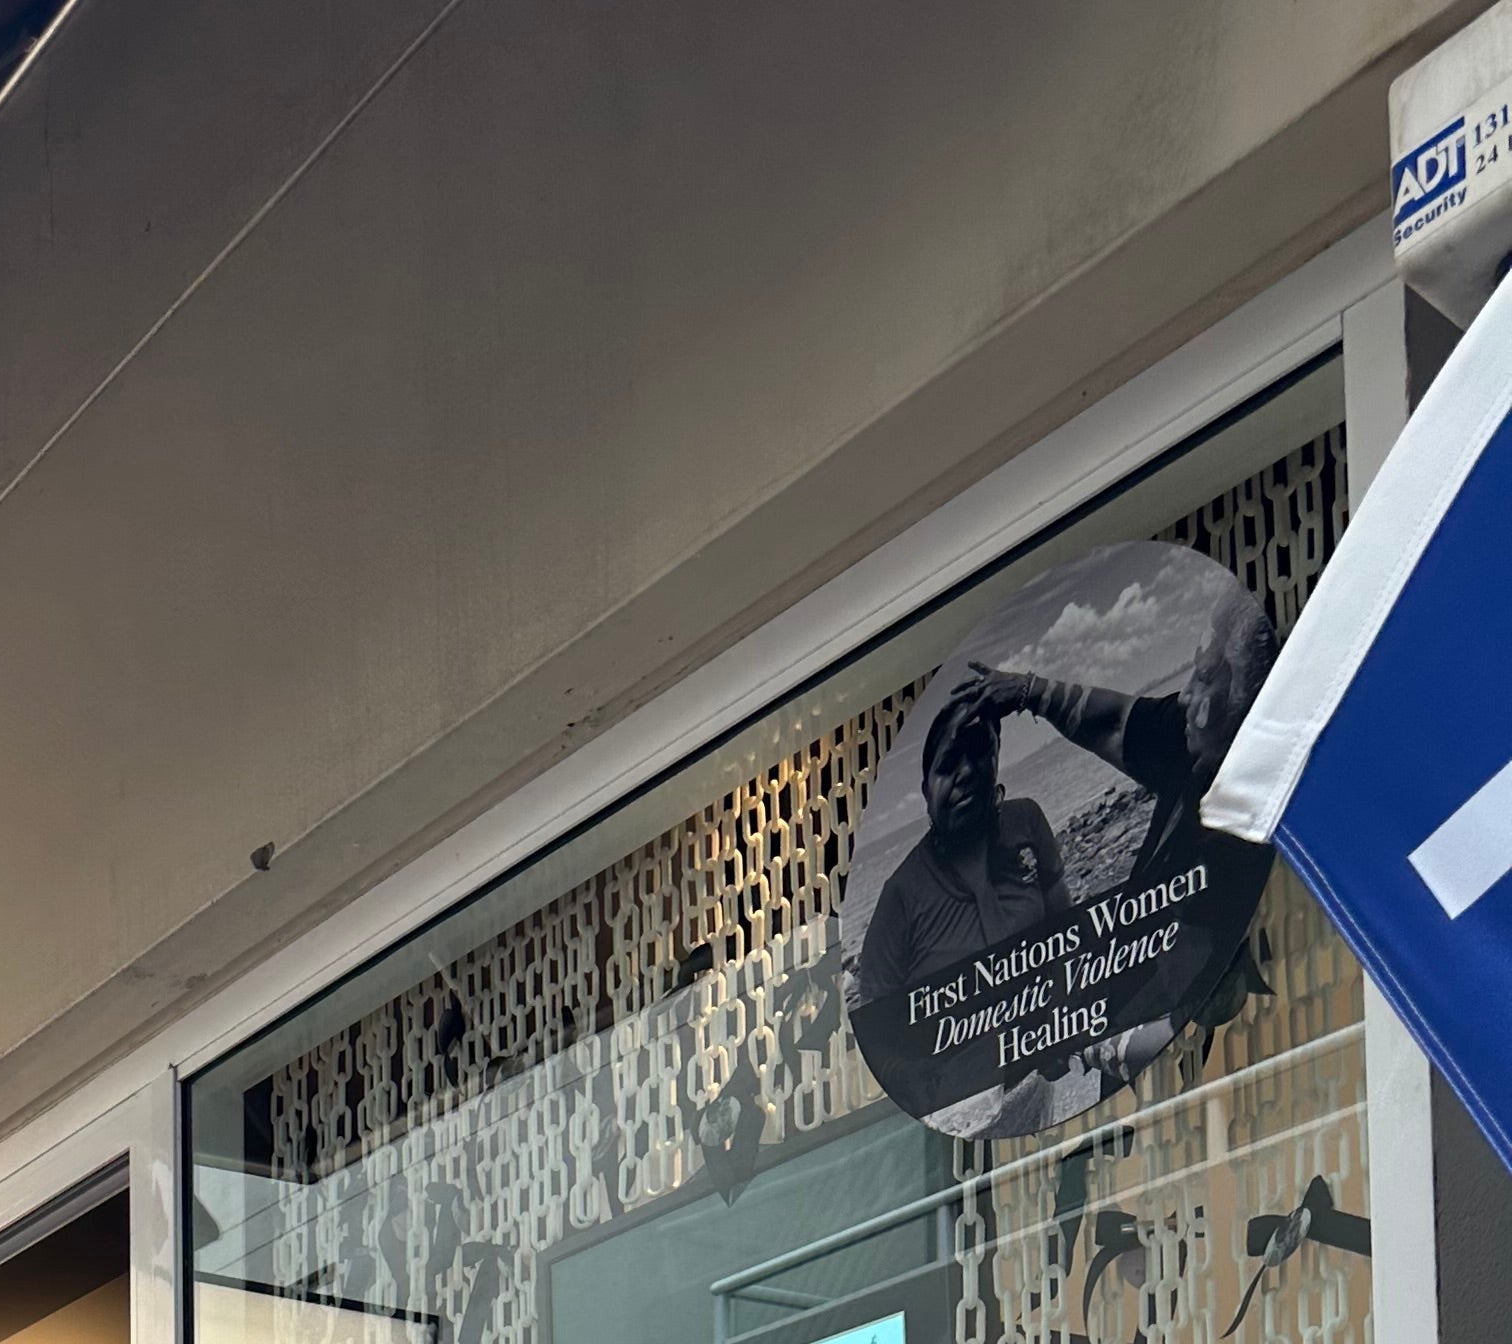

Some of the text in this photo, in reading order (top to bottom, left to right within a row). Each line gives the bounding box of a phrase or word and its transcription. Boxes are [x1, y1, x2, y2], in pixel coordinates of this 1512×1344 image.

[1393, 134, 1467, 218] ADT
[1474, 144, 1499, 176] 24
[1393, 187, 1467, 247] Security
[908, 863, 1208, 1026] First Nations Women
[932, 920, 1180, 1055] Domestic Violence
[997, 998, 1108, 1068] Healing
